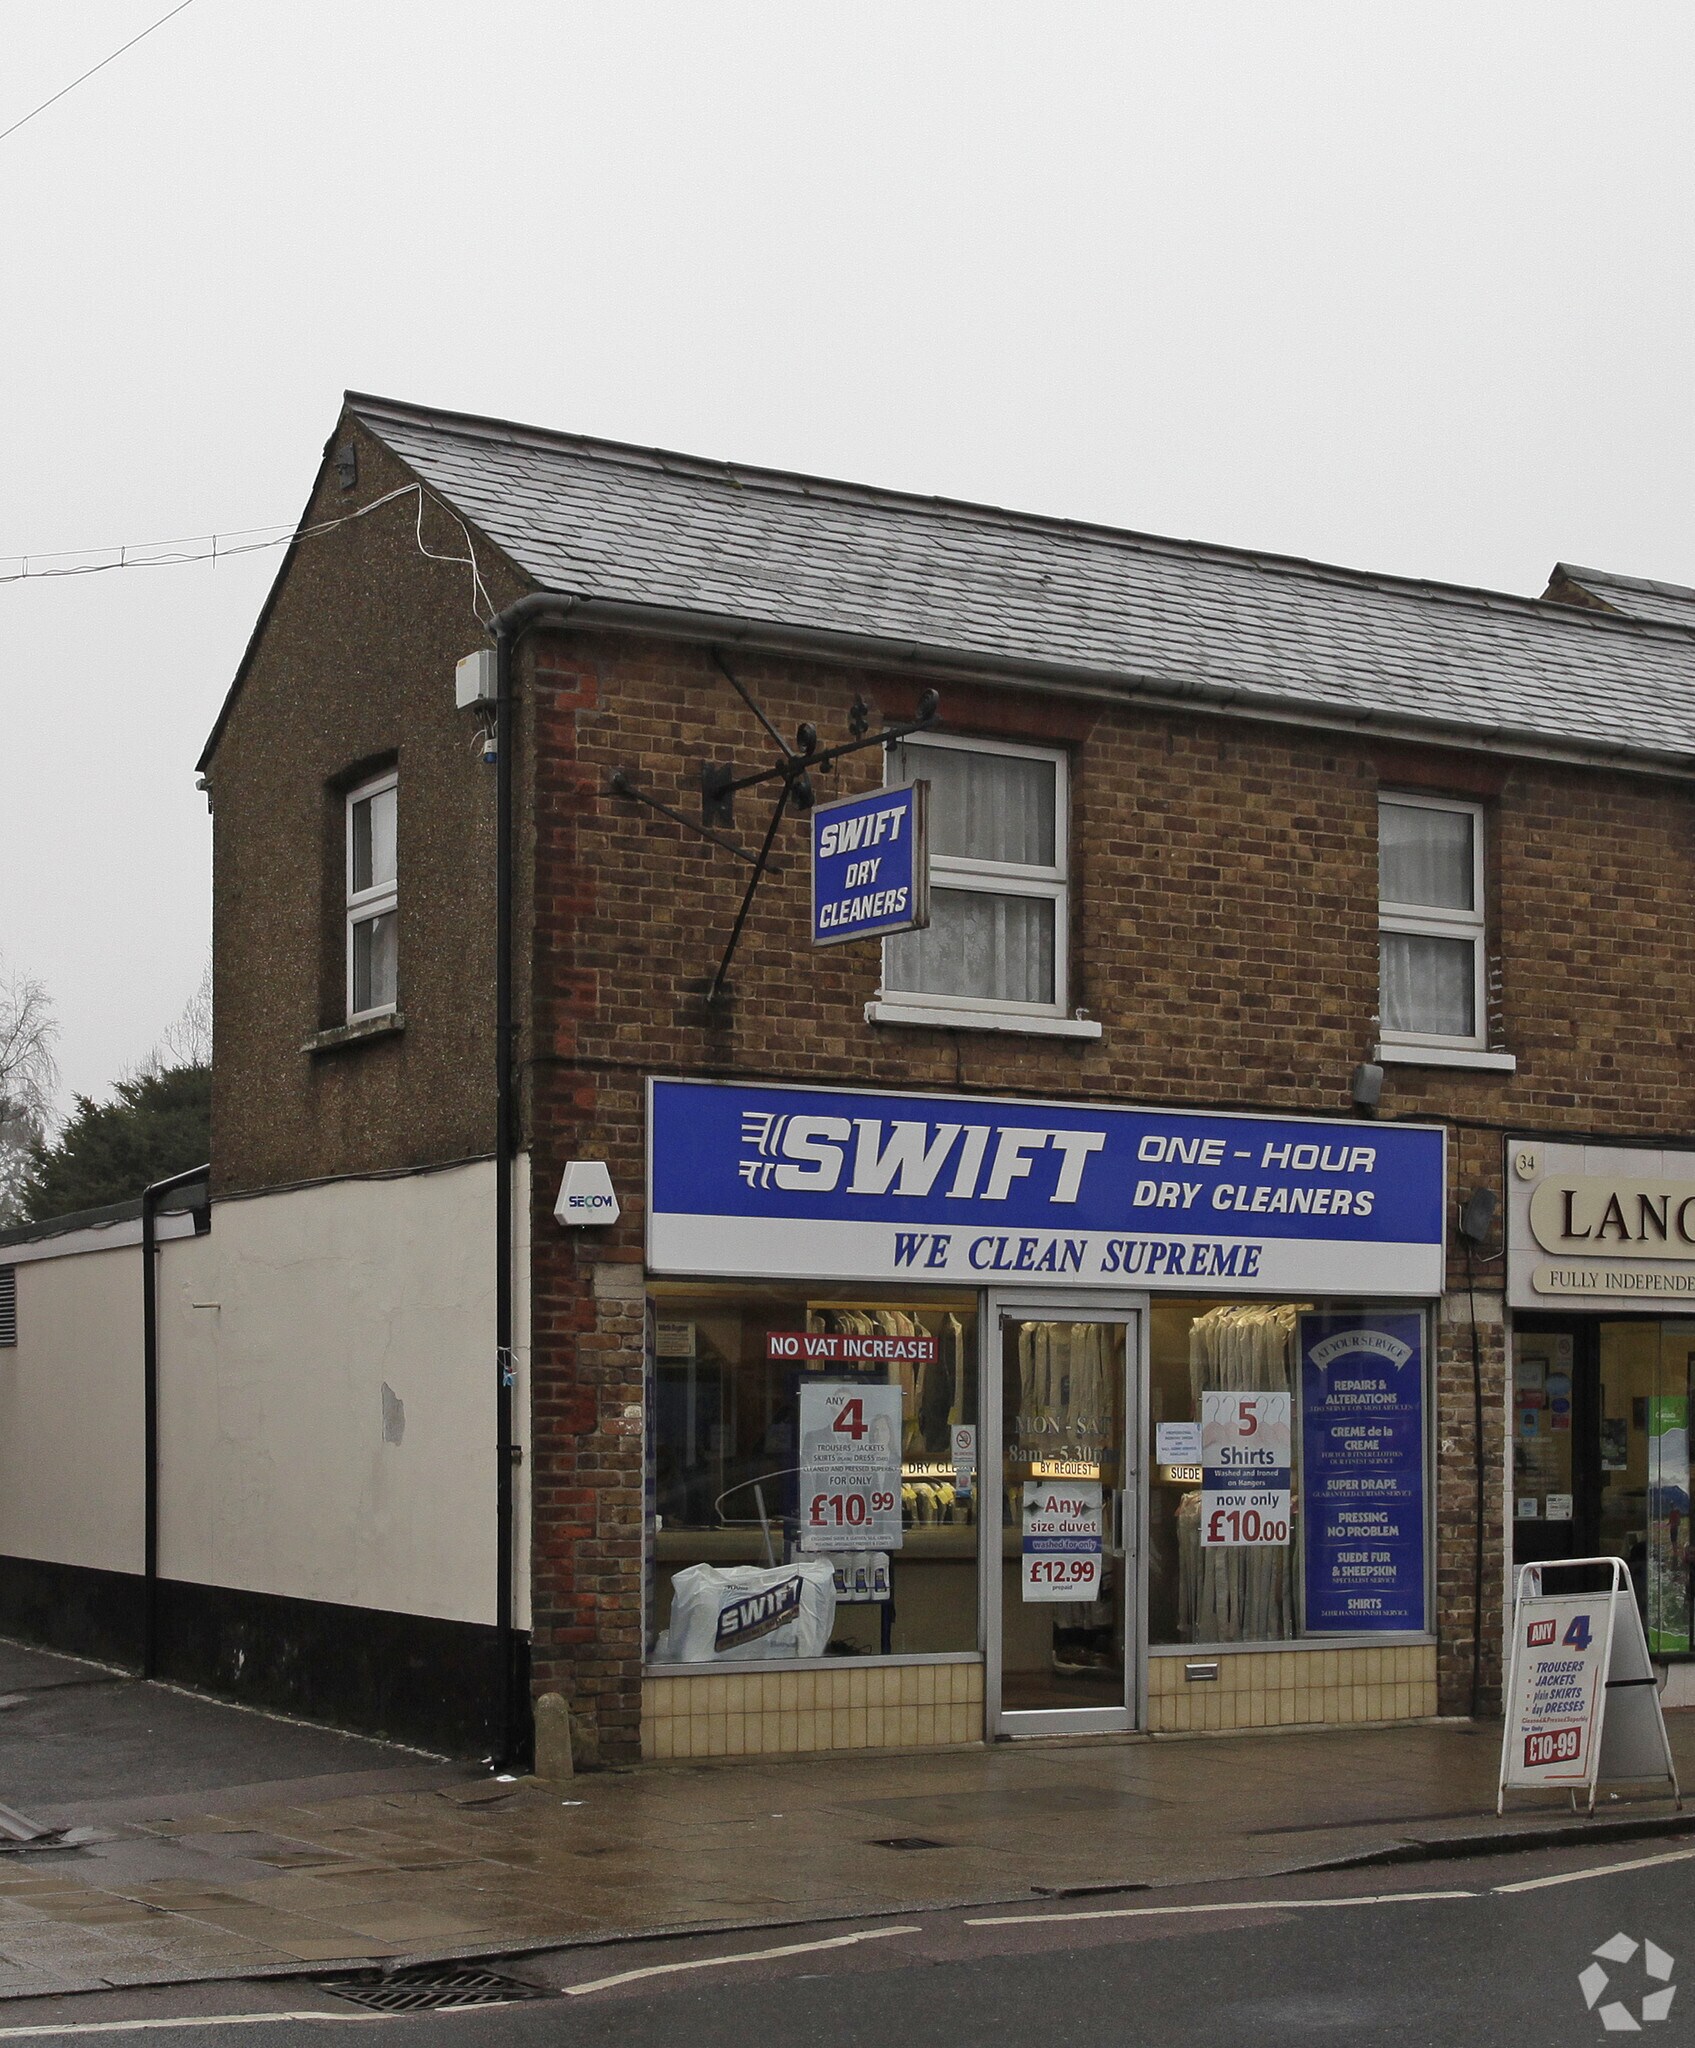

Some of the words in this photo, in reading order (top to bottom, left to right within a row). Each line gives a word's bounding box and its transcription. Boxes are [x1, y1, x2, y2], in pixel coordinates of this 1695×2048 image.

[819, 805, 908, 859] SWIFT
[845, 857, 882, 889] DRY
[819, 886, 909, 929] CLEANERS
[774, 1115, 1107, 1203] SWIFT
[1137, 1135, 1227, 1167] ONE
[1260, 1142, 1377, 1173] HOUR
[1519, 1154, 1535, 1170] 34
[568, 1195, 612, 1208] SECOM
[1132, 1180, 1203, 1209] DRY
[1211, 1184, 1375, 1217] CLEANERS
[893, 1232, 952, 1268] WE
[967, 1236, 1088, 1273] CLEAN
[1100, 1239, 1263, 1278] SUPREME
[1549, 1270, 1599, 1288] FULLY
[770, 1337, 799, 1355] NO
[803, 1338, 838, 1356] VAT
[842, 1339, 934, 1359] INCREASE!
[1329, 1337, 1360, 1352] YOUR
[1360, 1337, 1406, 1358] SERVICE
[1334, 1380, 1377, 1391] REPAIRS
[1378, 1379, 1387, 1390] &
[825, 1396, 845, 1406] ANY
[1325, 1393, 1397, 1405] ALTERATIONS
[833, 1398, 869, 1440] 4
[1014, 1416, 1061, 1434] MON
[1238, 1401, 1258, 1436] 5
[1331, 1427, 1366, 1437] CREME
[1367, 1426, 1382, 1437] de
[1383, 1426, 1393, 1437] la
[857, 1444, 885, 1452] JACKETS
[1344, 1440, 1379, 1450] CREME
[813, 1454, 836, 1462] SKIRTS
[854, 1454, 875, 1462] DRESS
[1009, 1444, 1043, 1462] 8am
[1220, 1447, 1275, 1465] Shirts
[908, 1463, 931, 1474] DRY
[1041, 1463, 1051, 1473] BY
[1054, 1463, 1093, 1475] REQUEST
[1171, 1467, 1200, 1480] SUEDE
[829, 1476, 847, 1485] FOR
[849, 1476, 872, 1485] ONLY
[1327, 1479, 1359, 1490] SUPER
[1361, 1479, 1397, 1489] DRAPE
[1045, 1496, 1083, 1517] Any
[1216, 1496, 1246, 1506] now
[1250, 1492, 1280, 1508] only
[809, 1492, 895, 1527] £10.99
[1338, 1512, 1388, 1523] PRESSING
[1030, 1520, 1055, 1532] size
[1059, 1519, 1097, 1532] duvet
[1207, 1509, 1287, 1542] £10.00
[1327, 1526, 1345, 1537] NO
[1347, 1525, 1399, 1537] PROBLEM
[1032, 1538, 1064, 1549] washed
[1064, 1538, 1077, 1548] for
[1077, 1539, 1097, 1551] only
[1337, 1552, 1369, 1563] SUEDE
[1370, 1552, 1391, 1562] FUR
[1030, 1560, 1095, 1583] £12.99
[1331, 1566, 1341, 1576] &
[1342, 1566, 1397, 1576] SHEEPSKIN
[1347, 1598, 1382, 1609] SHIRTS
[1531, 1623, 1553, 1642] ANY
[1562, 1615, 1593, 1651] 4
[1536, 1661, 1584, 1673] TROUSERS
[1535, 1674, 1576, 1687] JACKETS
[1549, 1687, 1582, 1699] SKIRTS
[1532, 1704, 1544, 1717] day
[1544, 1701, 1585, 1713] DRESSES
